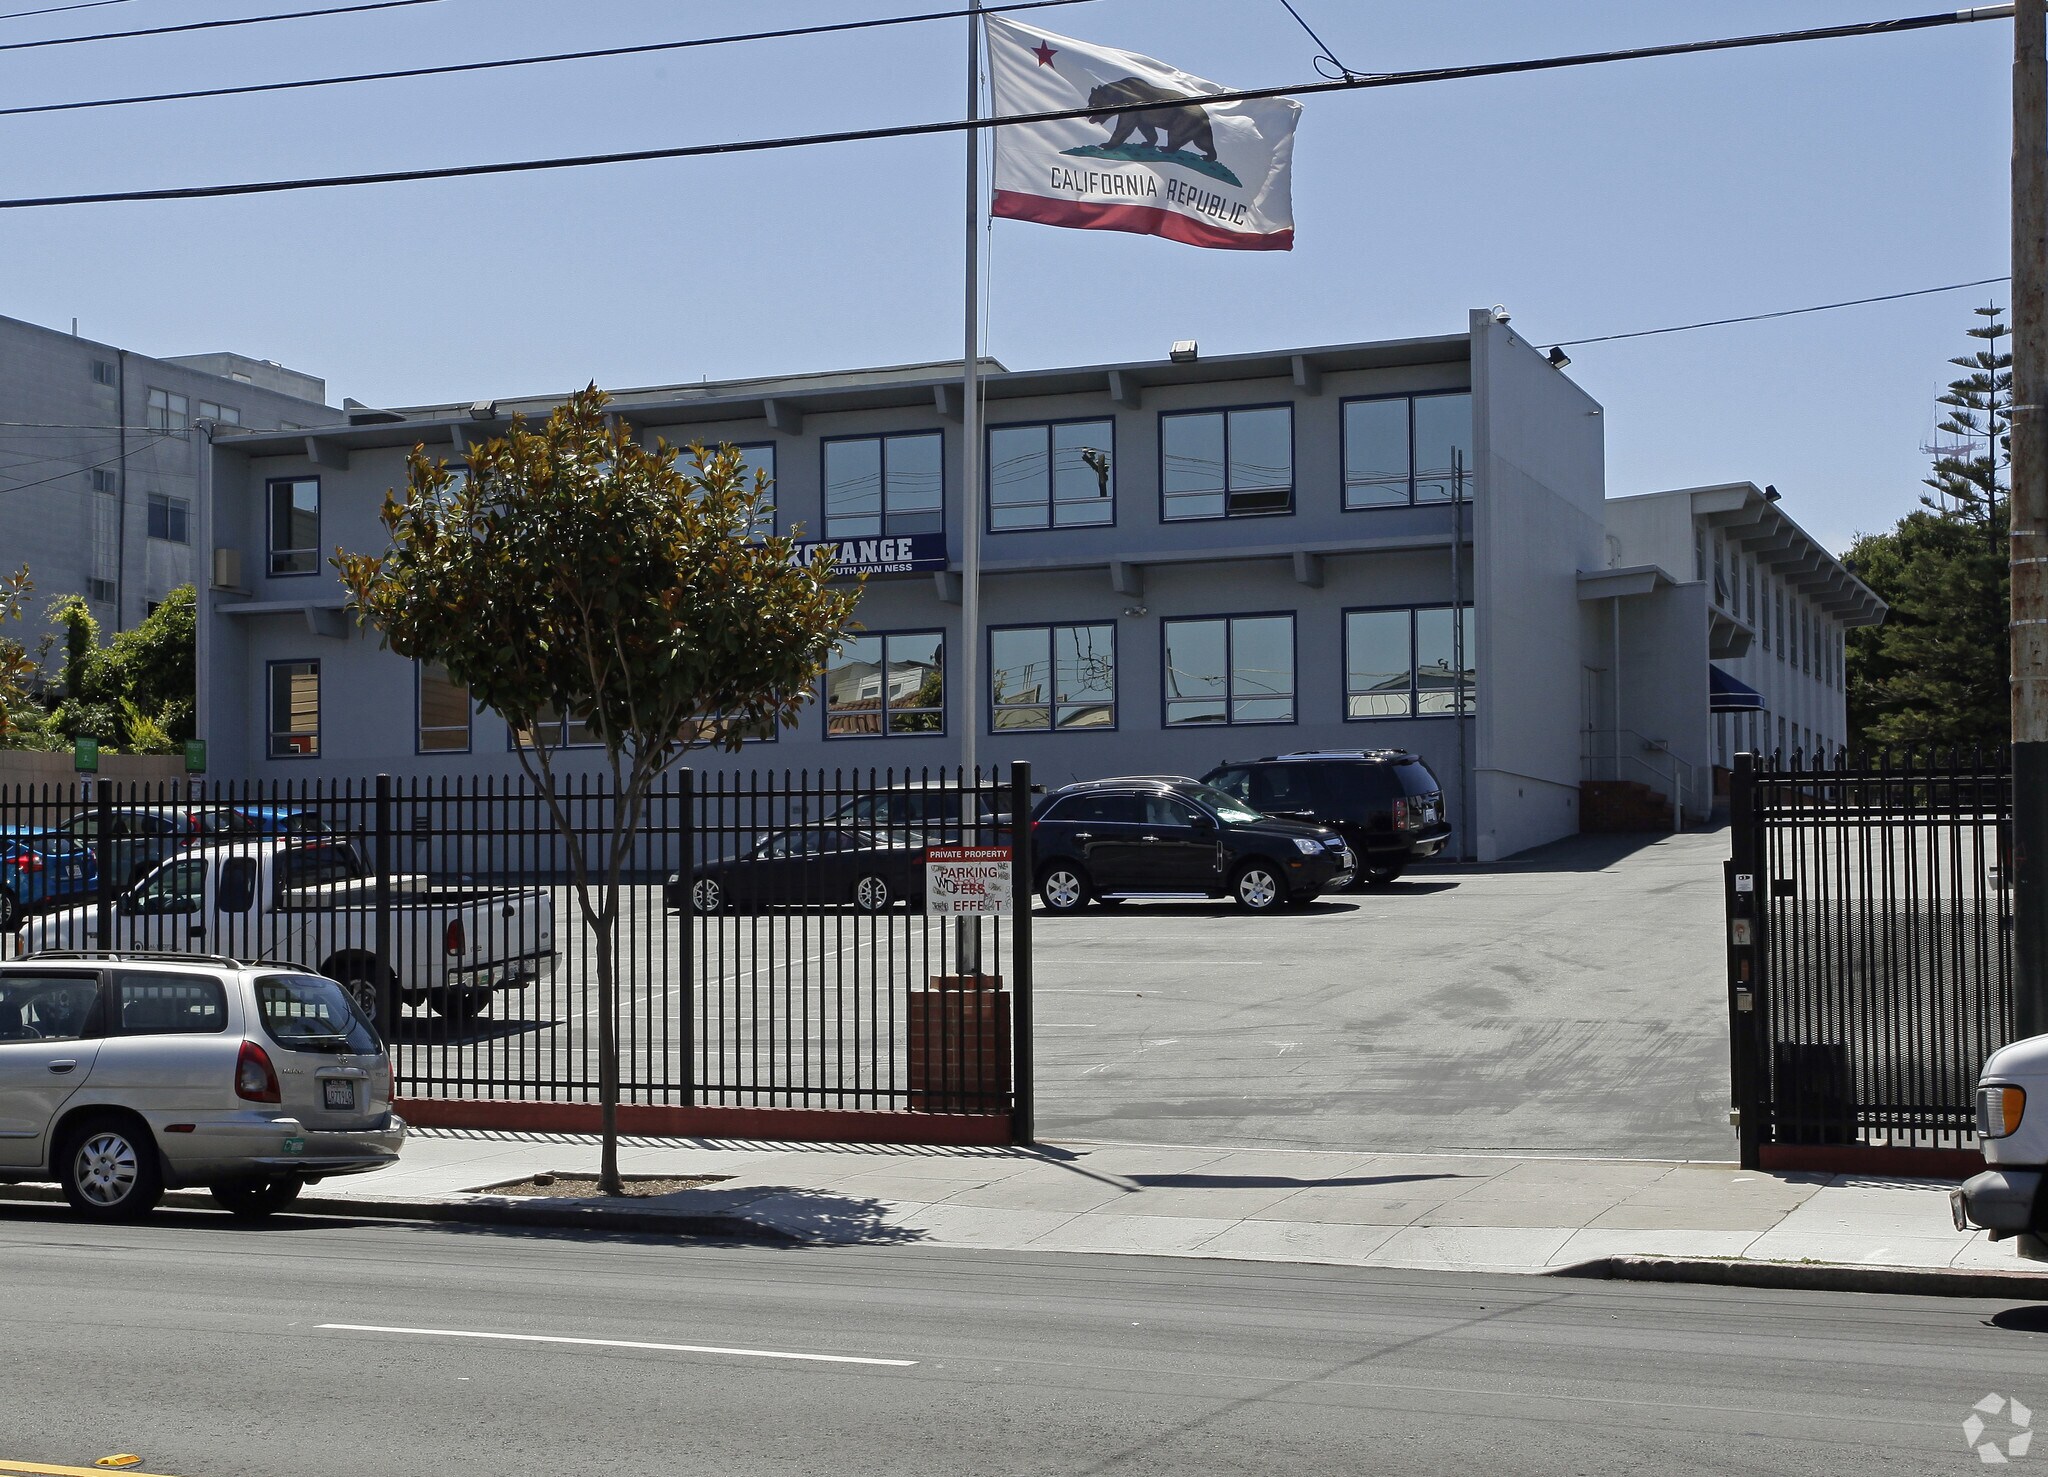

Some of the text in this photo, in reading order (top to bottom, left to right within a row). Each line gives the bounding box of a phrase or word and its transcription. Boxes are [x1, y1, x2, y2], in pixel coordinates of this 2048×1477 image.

[1051, 167, 1247, 226] CALIFORNIA REPUBLIC
[779, 538, 913, 567] XCANGE
[827, 563, 913, 576] OUTH VAN NESS
[930, 850, 1007, 858] PRIVATE PROPERTY
[941, 867, 998, 878] PARKING
[953, 900, 1002, 911] EFFET
